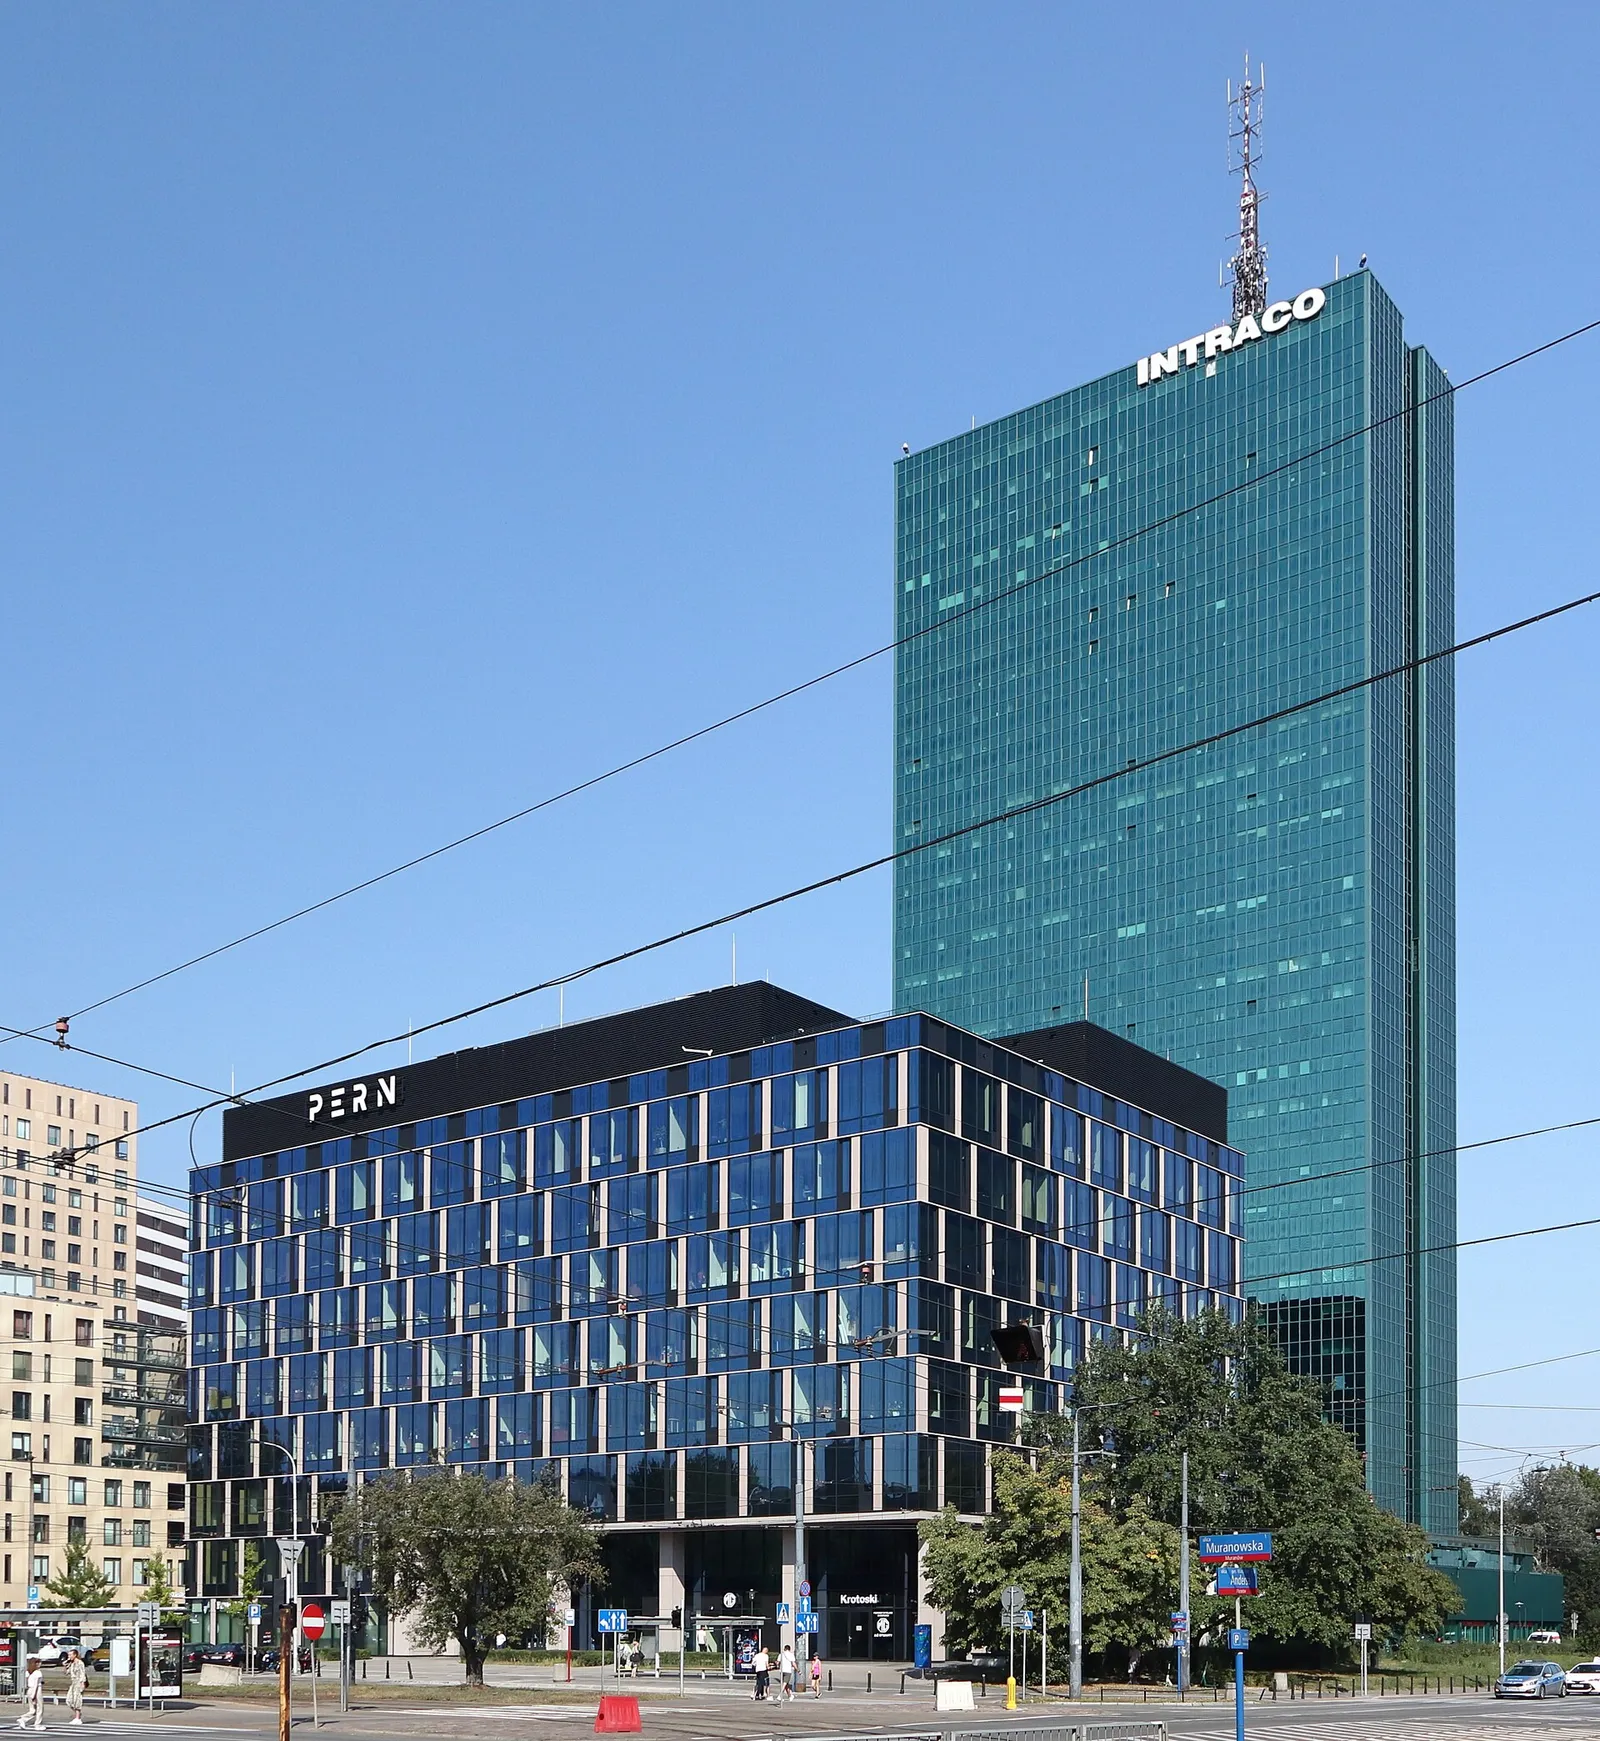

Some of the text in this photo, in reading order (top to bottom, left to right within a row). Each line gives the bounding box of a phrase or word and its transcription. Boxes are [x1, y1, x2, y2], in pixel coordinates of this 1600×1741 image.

[1137, 287, 1326, 386] INTRACO
[309, 1075, 396, 1122] PERN
[1206, 1540, 1264, 1553] Muranowska
[840, 1594, 878, 1604] Krotoski
